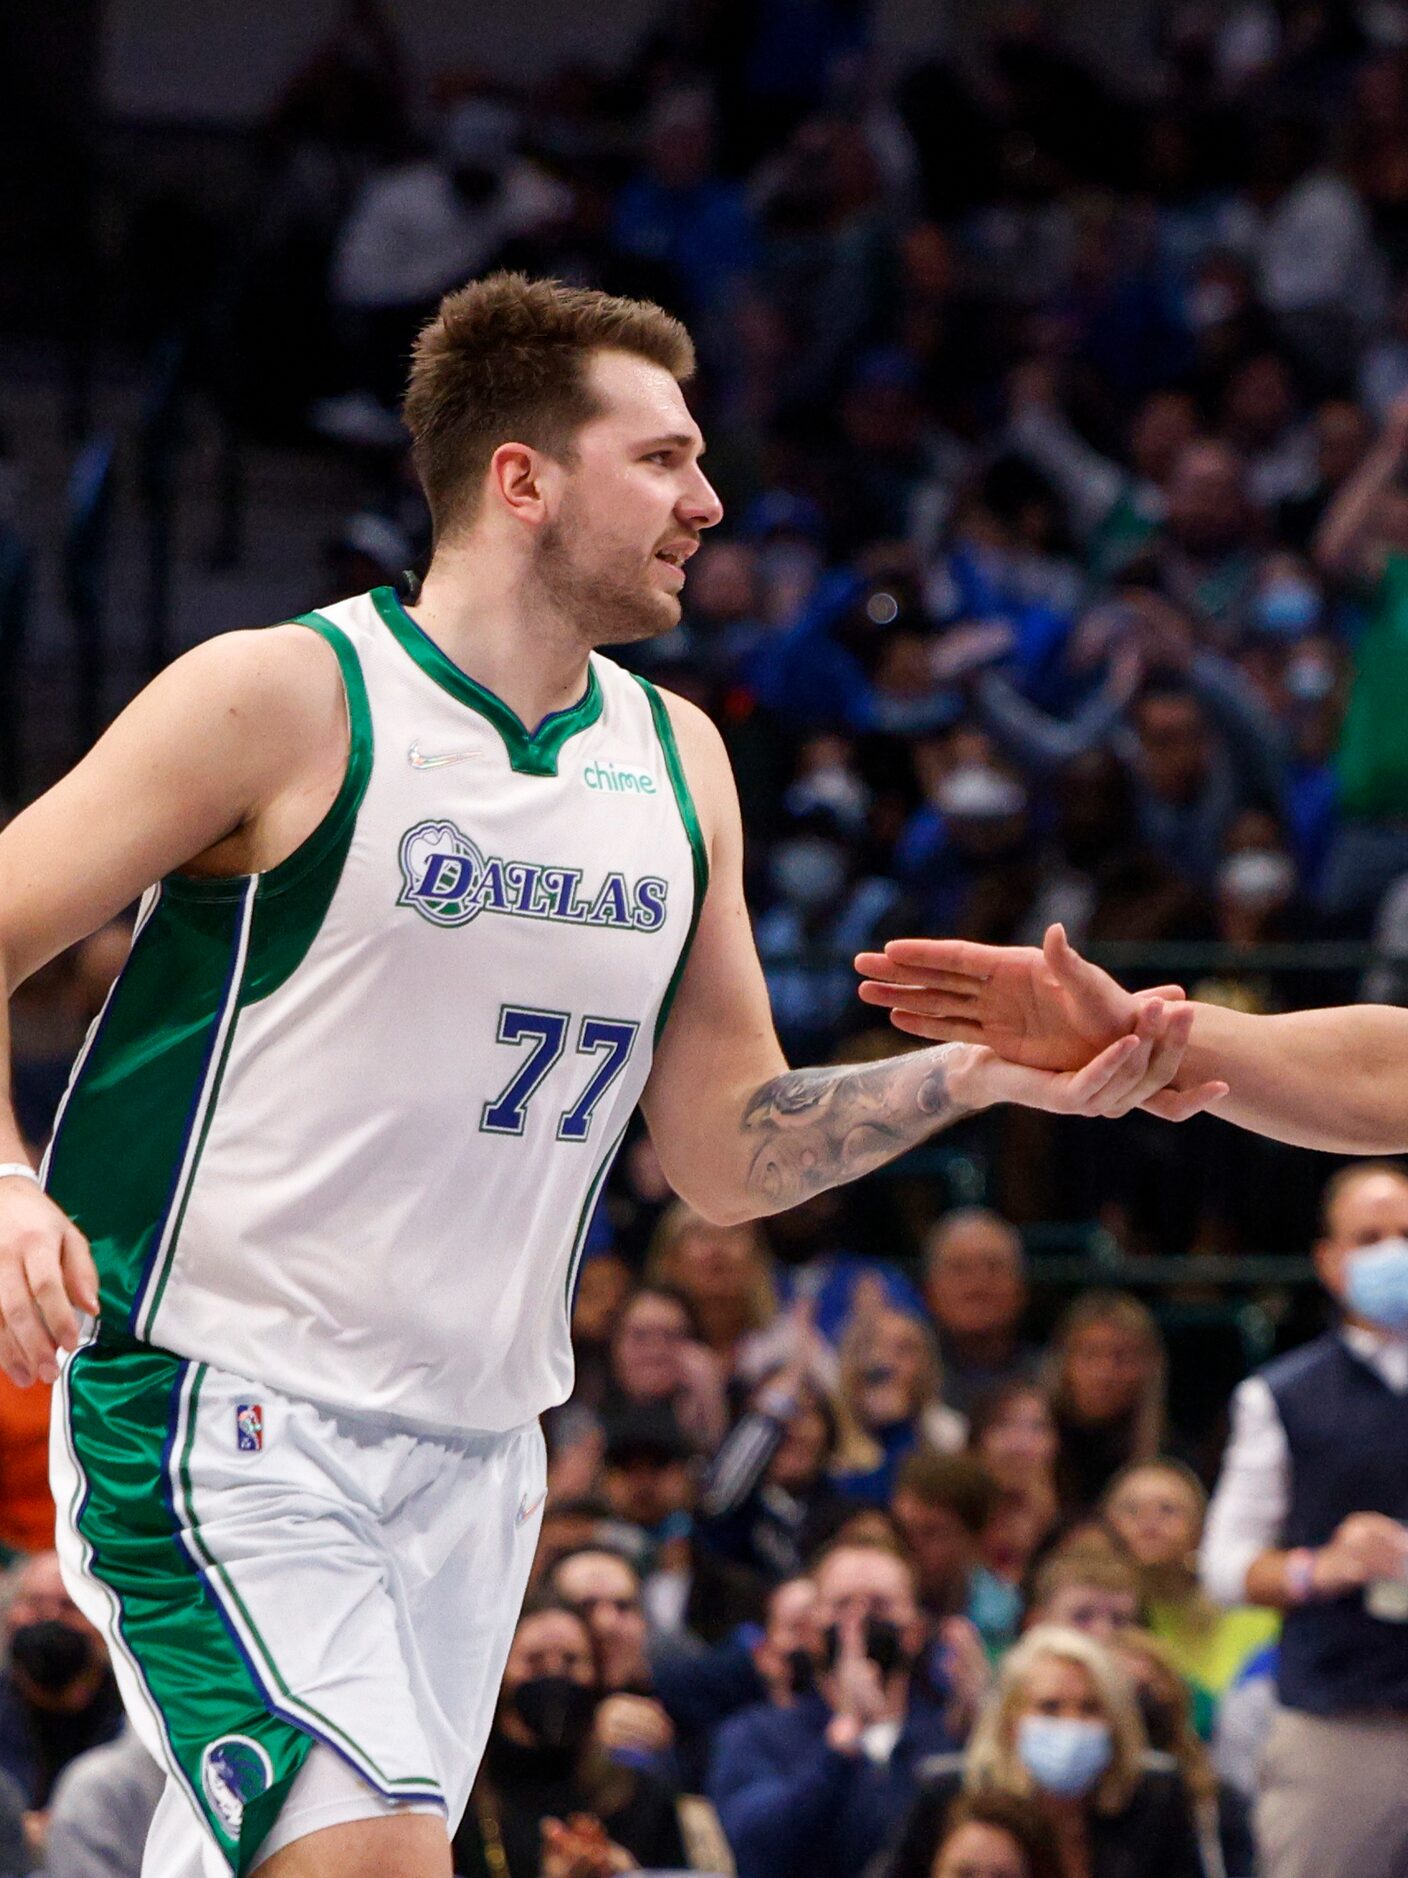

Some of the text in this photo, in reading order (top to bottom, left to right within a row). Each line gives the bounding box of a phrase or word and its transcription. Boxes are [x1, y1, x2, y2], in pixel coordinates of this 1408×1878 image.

[583, 763, 657, 795] chime
[402, 852, 669, 934] DALLAS
[479, 1003, 640, 1142] 77
